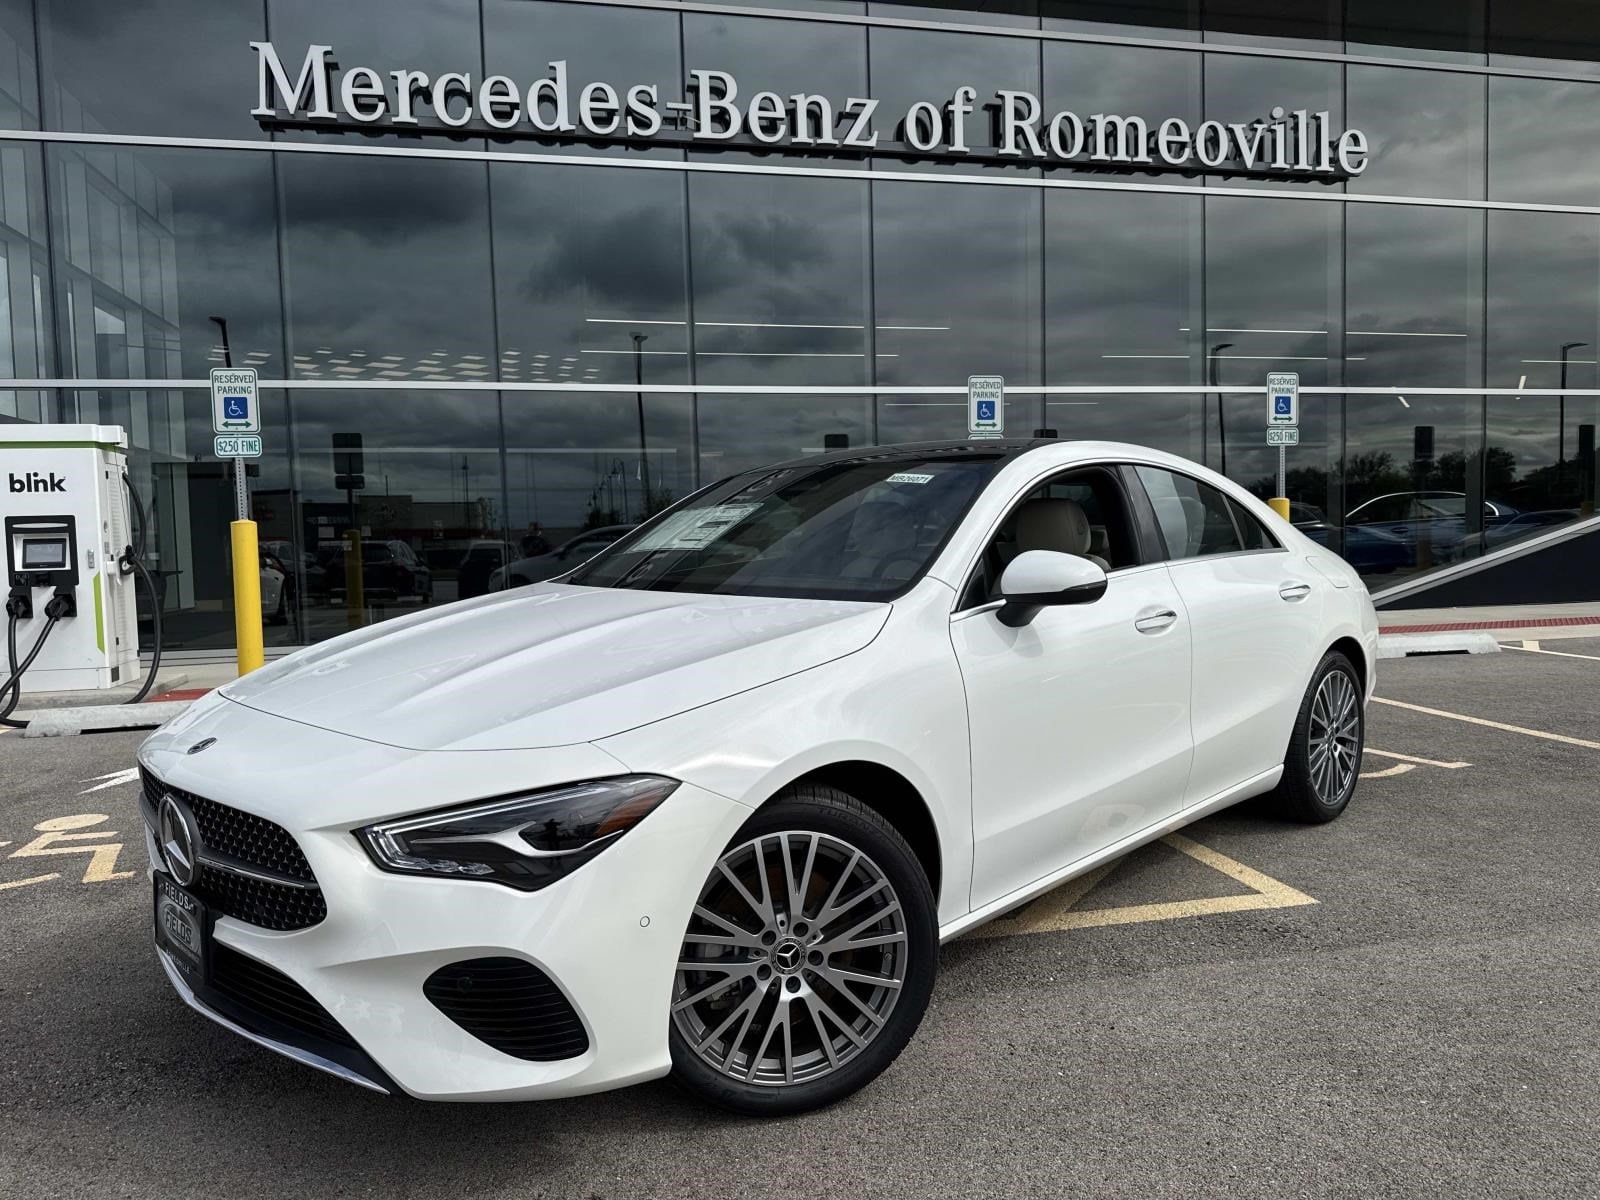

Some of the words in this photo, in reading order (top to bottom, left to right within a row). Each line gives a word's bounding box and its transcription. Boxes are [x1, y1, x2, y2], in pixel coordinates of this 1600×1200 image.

[249, 41, 878, 147] Mercedes-Benz
[905, 86, 977, 152] of
[998, 90, 1369, 177] Romeoville
[213, 374, 254, 384] RESERVED
[1269, 377, 1297, 386] RESERVED
[217, 385, 253, 395] PARKING
[971, 381, 1001, 390] RESERVED
[972, 391, 999, 399] PARKING
[1271, 387, 1295, 395] PARKING
[1269, 431, 1284, 442] $250
[1284, 431, 1297, 442] FINE
[217, 440, 239, 453] $250
[241, 440, 259, 453] FINE
[8, 472, 67, 493] blink
[165, 881, 189, 910] FIELDS
[166, 911, 192, 945] FIELDS
